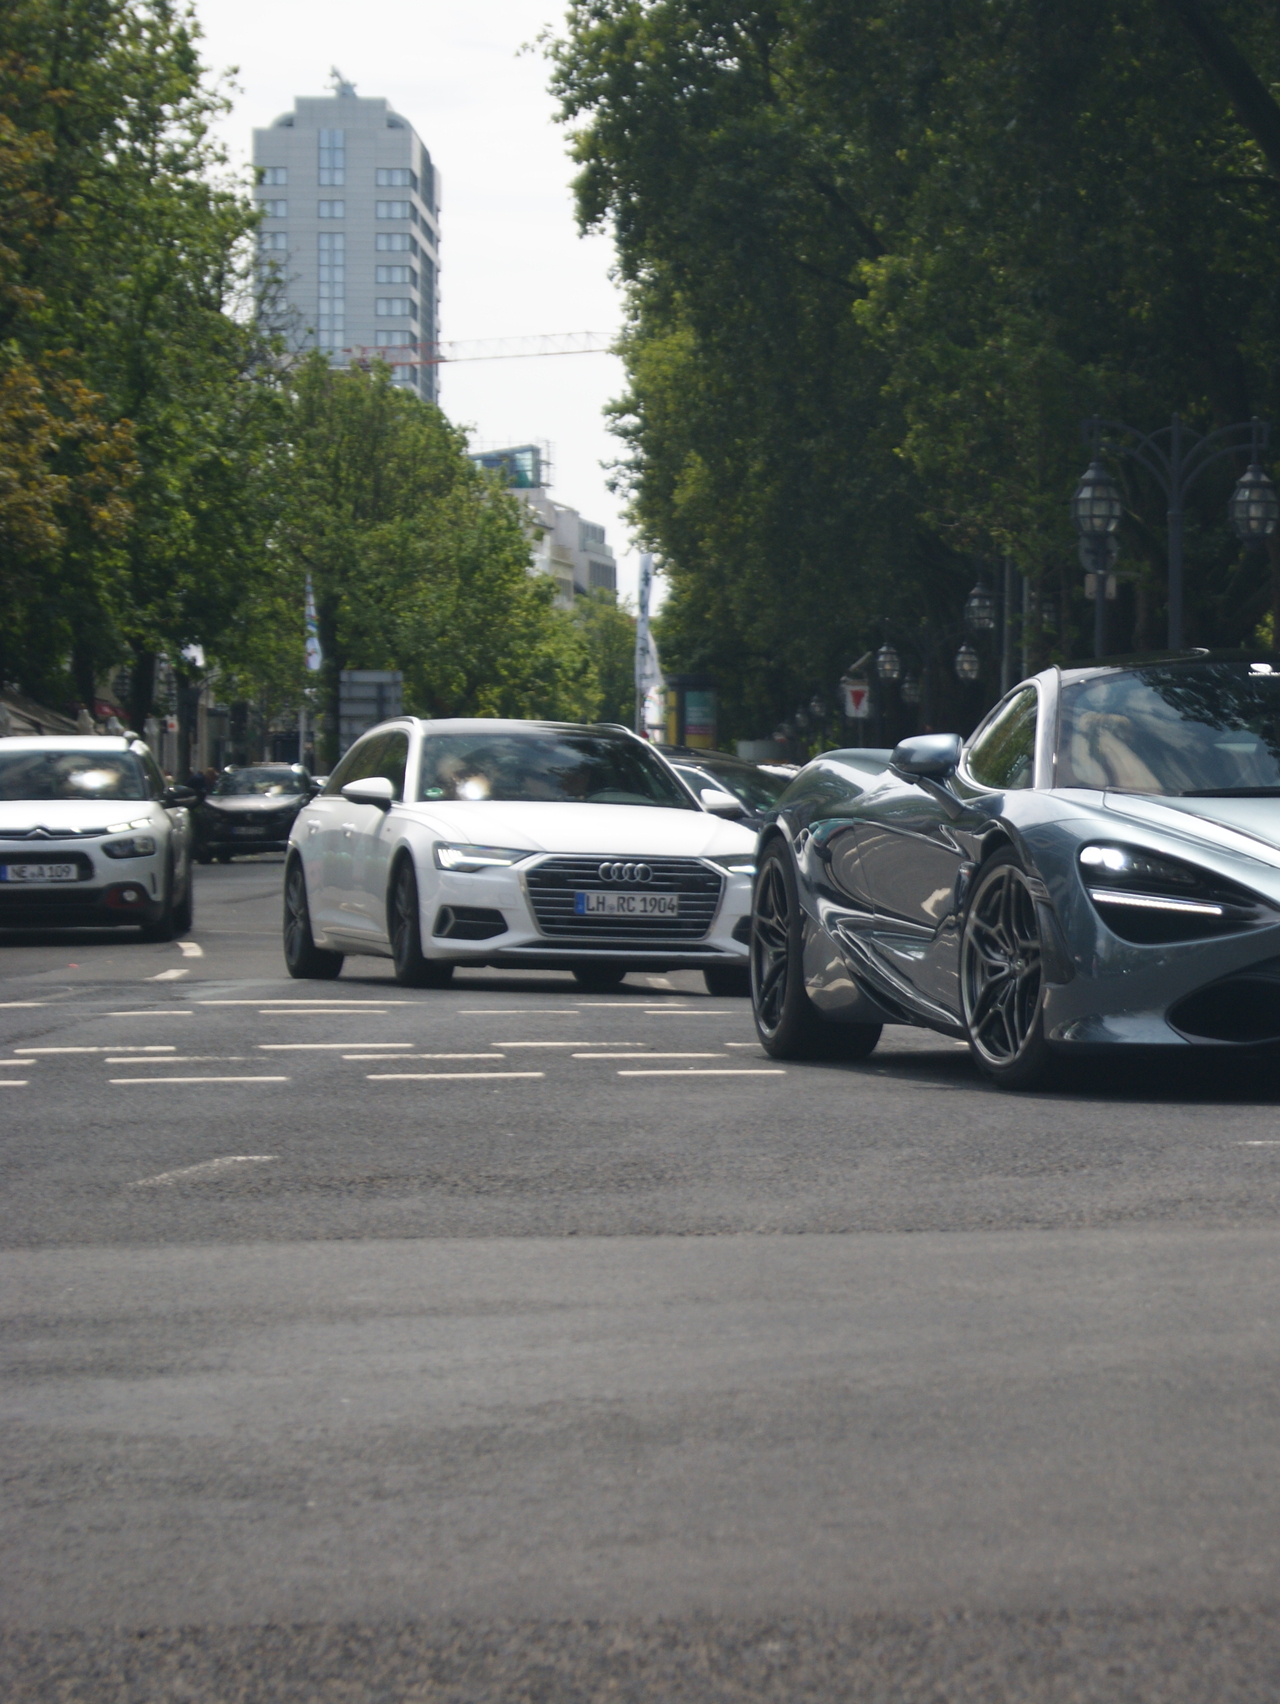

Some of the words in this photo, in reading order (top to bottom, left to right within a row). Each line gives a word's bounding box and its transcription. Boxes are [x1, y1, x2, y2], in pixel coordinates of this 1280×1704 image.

[586, 895, 605, 911] LH
[617, 896, 635, 913] RC
[639, 897, 676, 914] 1904
